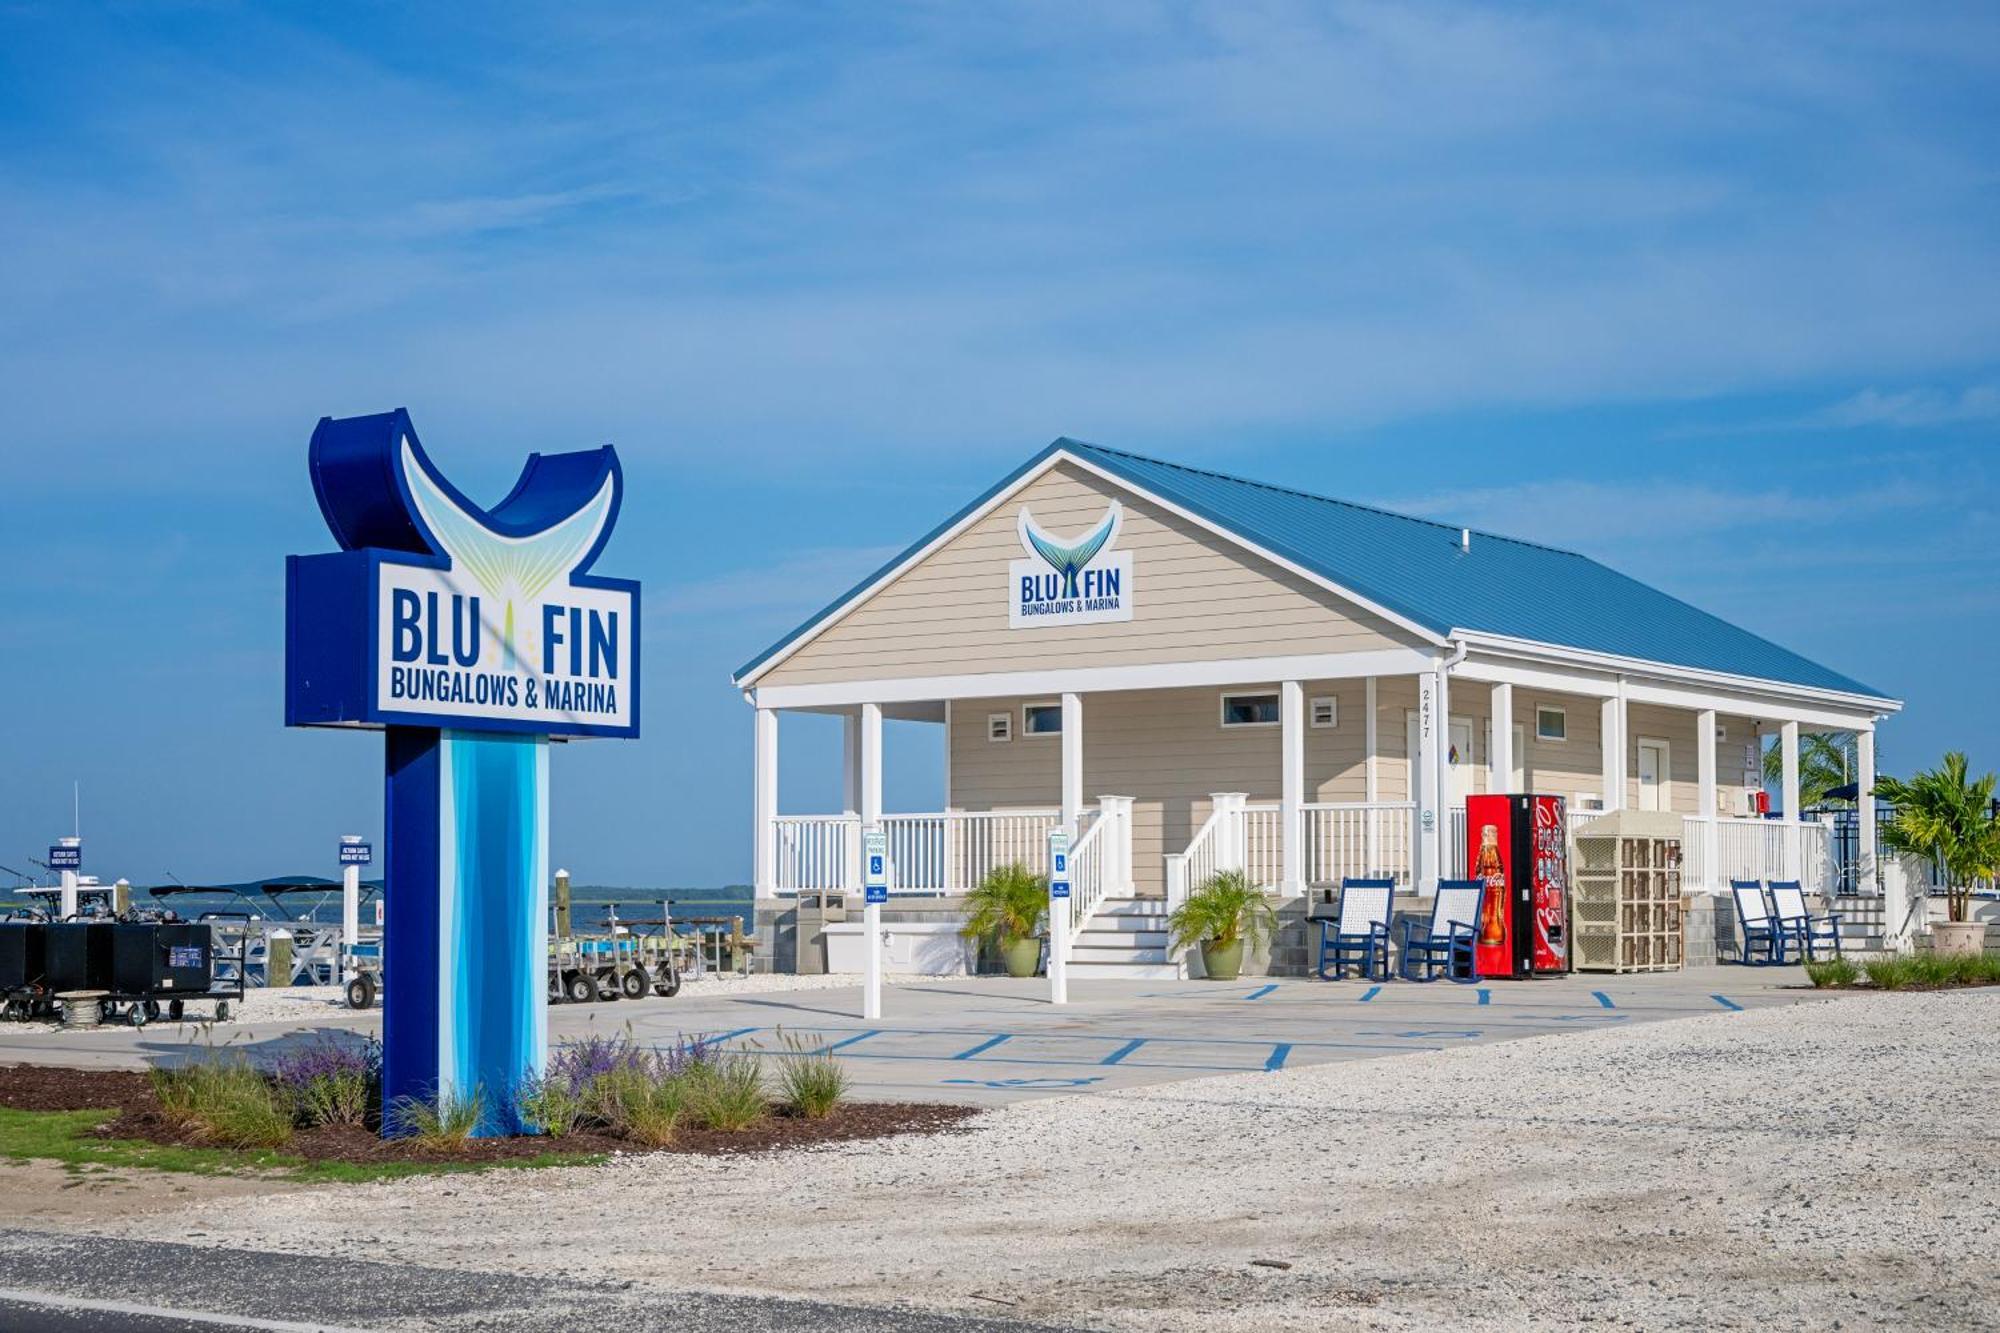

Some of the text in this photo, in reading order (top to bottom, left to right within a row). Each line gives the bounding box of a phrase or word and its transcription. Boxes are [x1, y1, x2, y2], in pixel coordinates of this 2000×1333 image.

[1021, 568, 1120, 603] BLU FIN
[1021, 597, 1120, 616] BUNGALOWS & MARINA
[392, 588, 618, 679] BLU FIN
[391, 667, 617, 714] BUNGALOWS & MARINA
